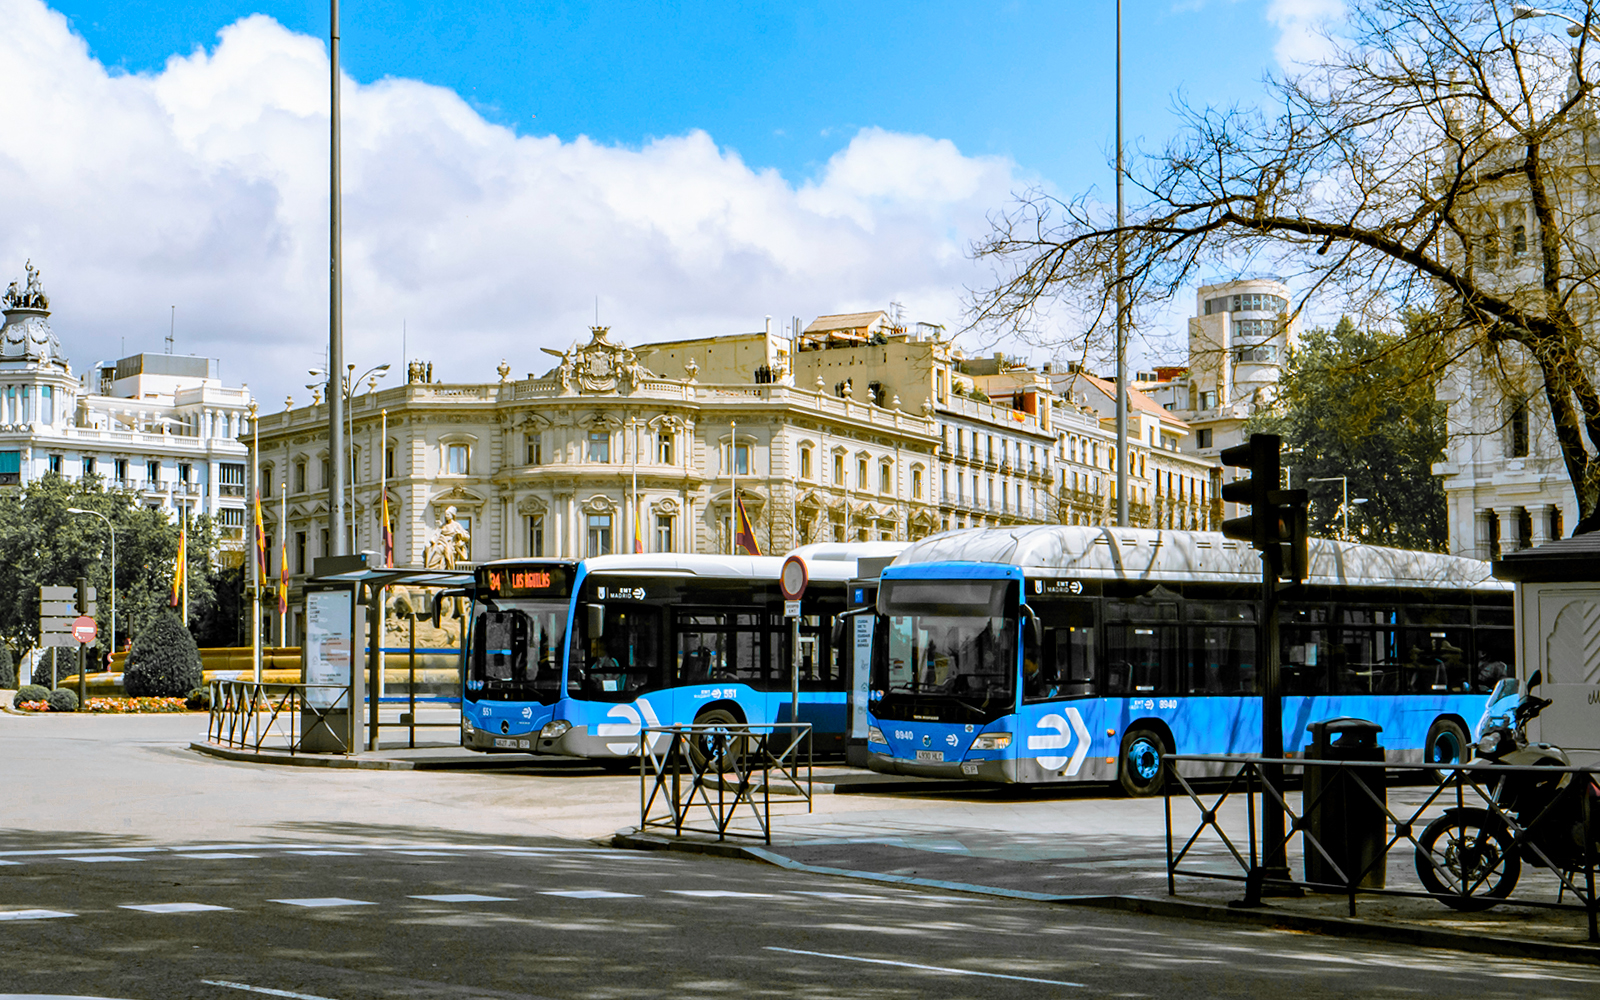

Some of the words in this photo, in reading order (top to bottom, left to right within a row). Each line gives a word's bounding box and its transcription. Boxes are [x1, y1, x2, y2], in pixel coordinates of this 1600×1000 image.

[489, 572, 501, 591] 34
[512, 572, 524, 588] LAS
[723, 688, 737, 699] 551
[1158, 699, 1178, 709] 8940
[482, 707, 493, 717] 551
[895, 730, 914, 740] 8940
[964, 765, 976, 774] SP
